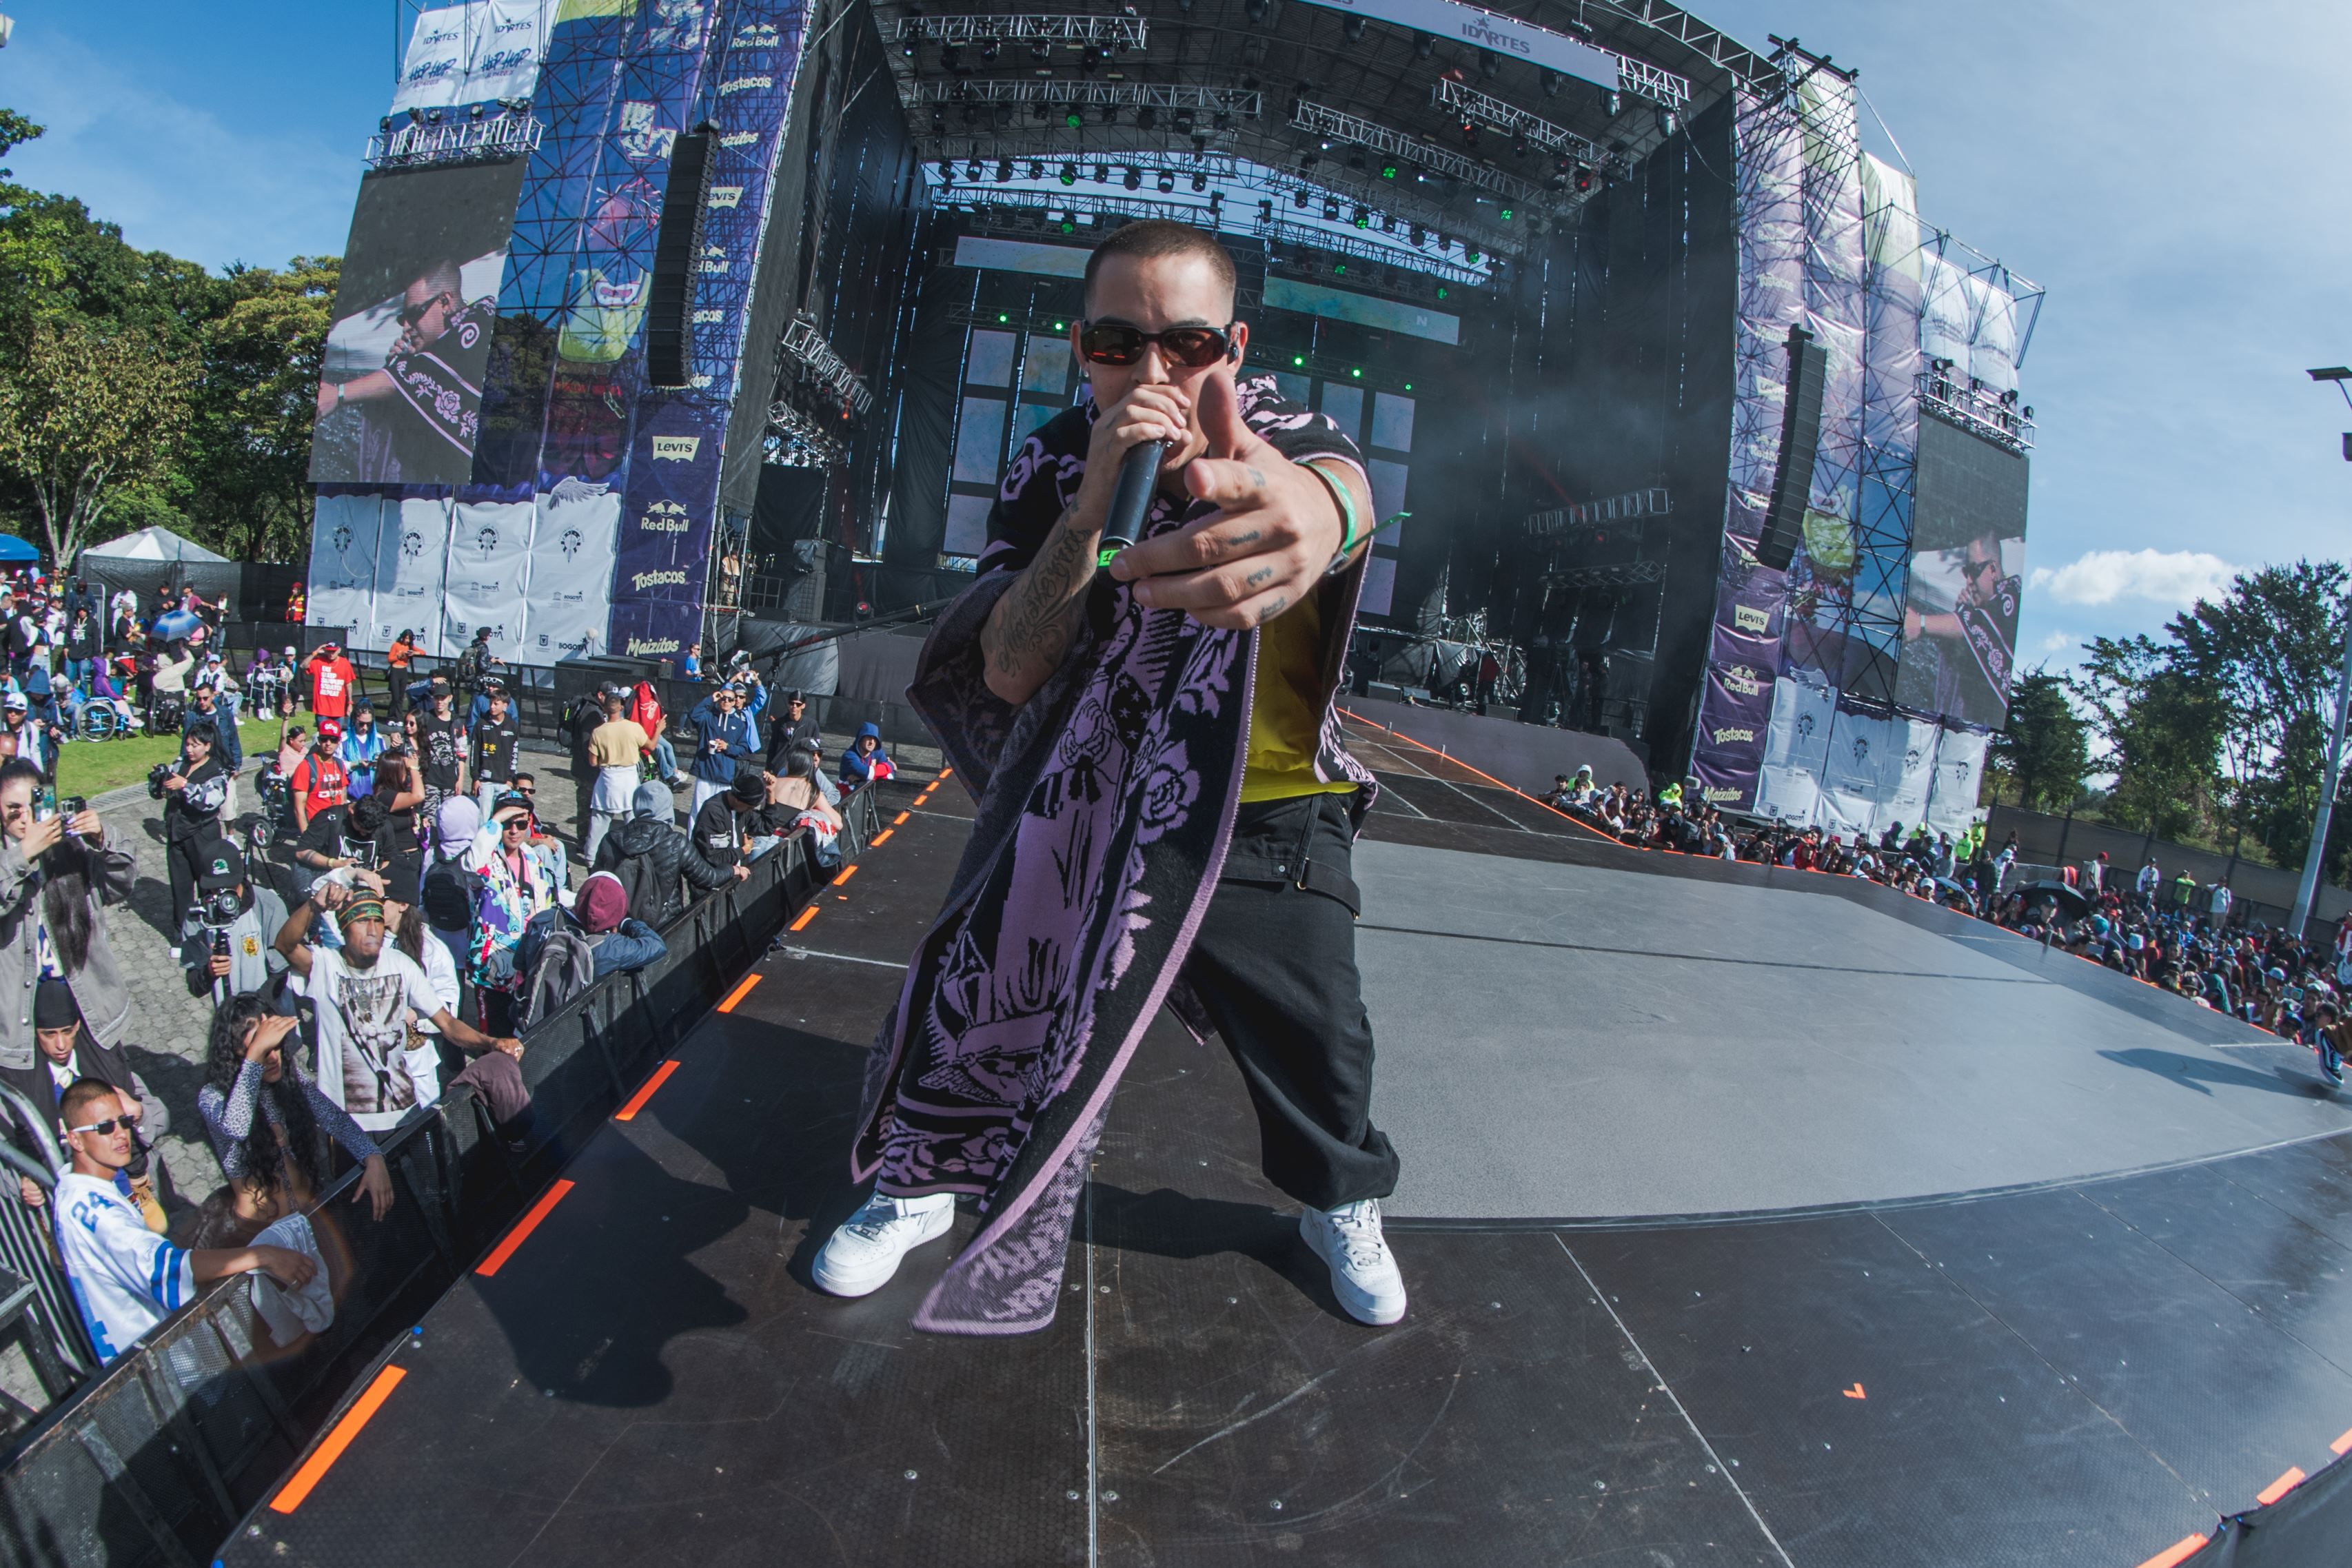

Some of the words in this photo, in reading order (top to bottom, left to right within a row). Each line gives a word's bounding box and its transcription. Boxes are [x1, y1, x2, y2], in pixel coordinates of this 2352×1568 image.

[731, 37, 755, 48] Red
[755, 35, 780, 48] Bull
[1461, 22, 1530, 54] IDARTES
[719, 77, 771, 96] Tostacos
[704, 261, 729, 273] Bull
[1417, 315, 1428, 327] N
[641, 517, 665, 531] Red
[666, 518, 689, 532] Bull
[631, 569, 686, 591] Tostacos
[626, 637, 680, 657] Maizitos
[1724, 678, 1742, 692] Red
[1742, 682, 1758, 696] Bull
[1714, 727, 1753, 744] Tostacos
[1703, 786, 1743, 804] Maizitos
[71, 1191, 116, 1234] 24
